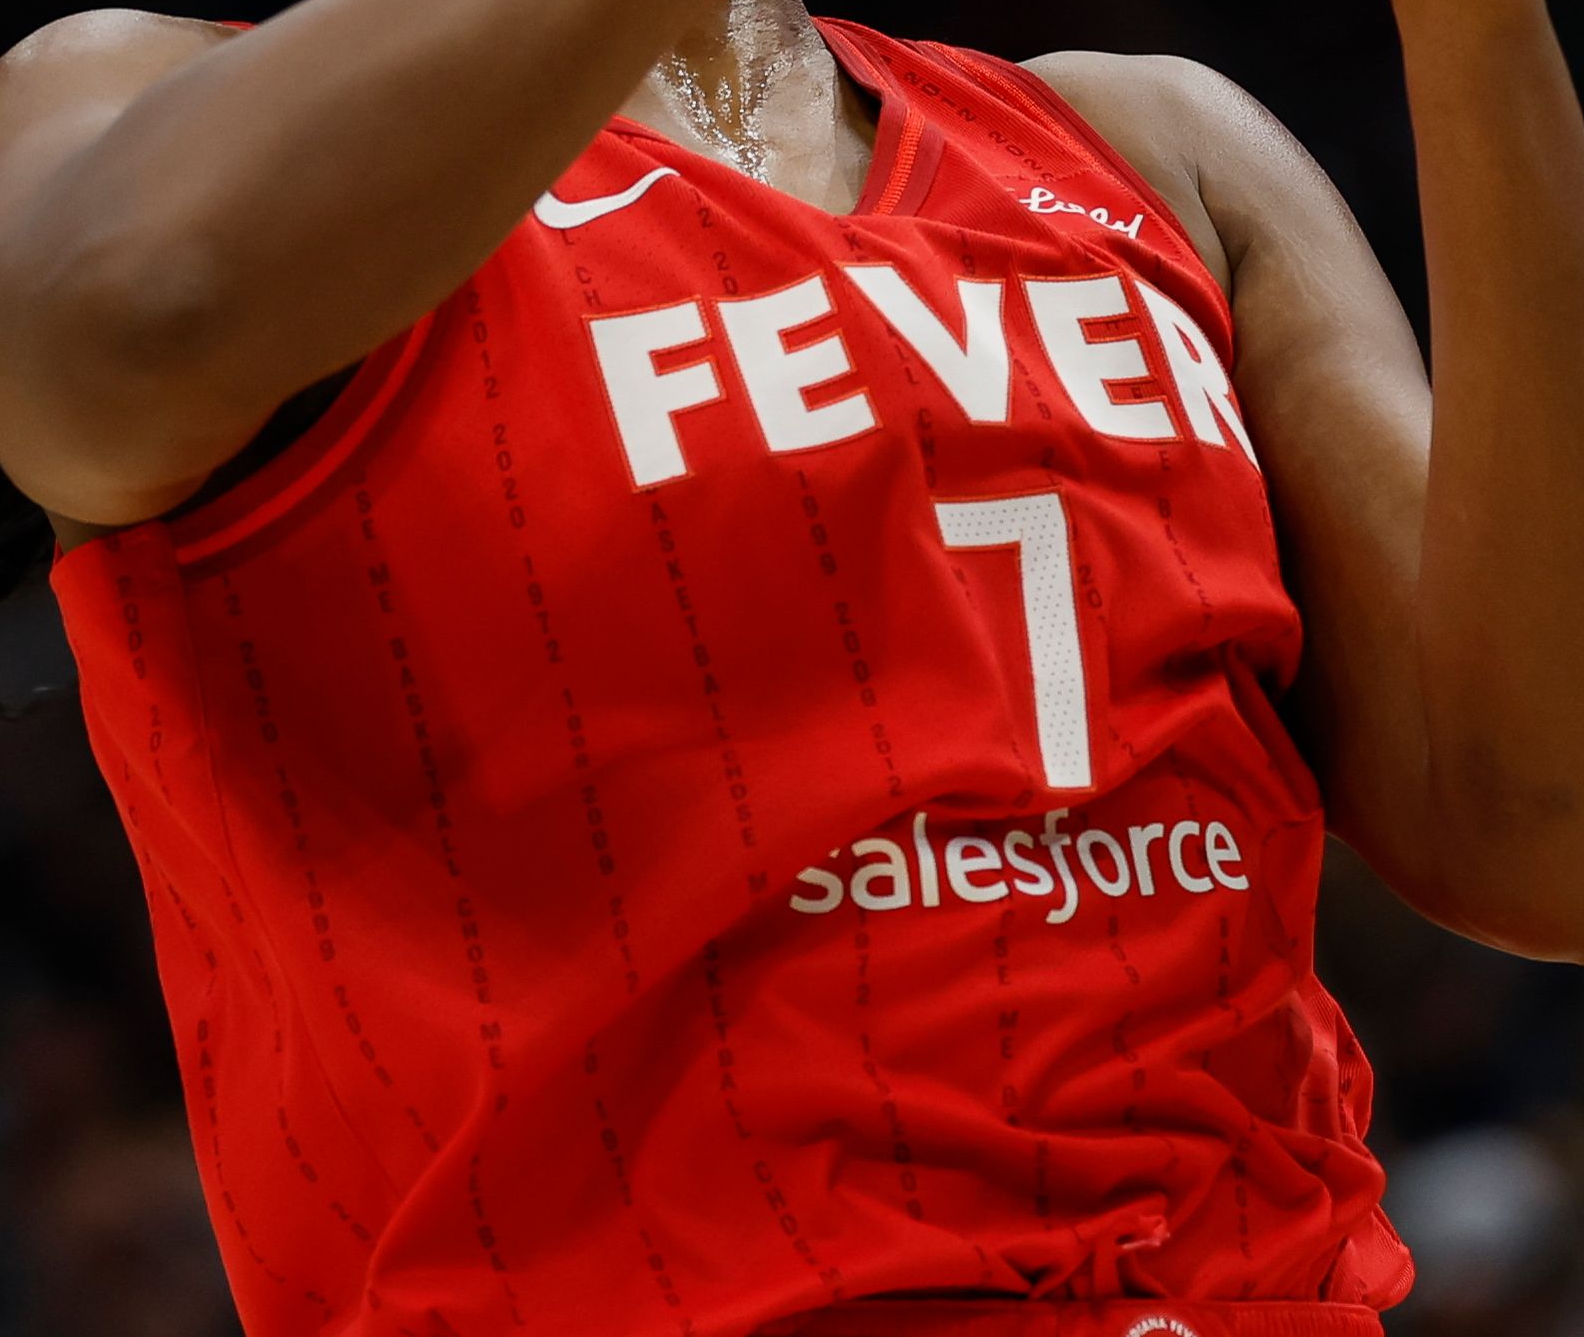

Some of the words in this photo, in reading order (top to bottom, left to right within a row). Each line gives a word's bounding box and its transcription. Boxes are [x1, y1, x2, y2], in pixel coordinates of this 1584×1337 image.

[492, 423, 526, 530] 2020
[586, 263, 1263, 493] FEVER
[646, 488, 730, 741] ASKETBALL
[933, 492, 1094, 791] 7
[789, 807, 1249, 924] salesforce
